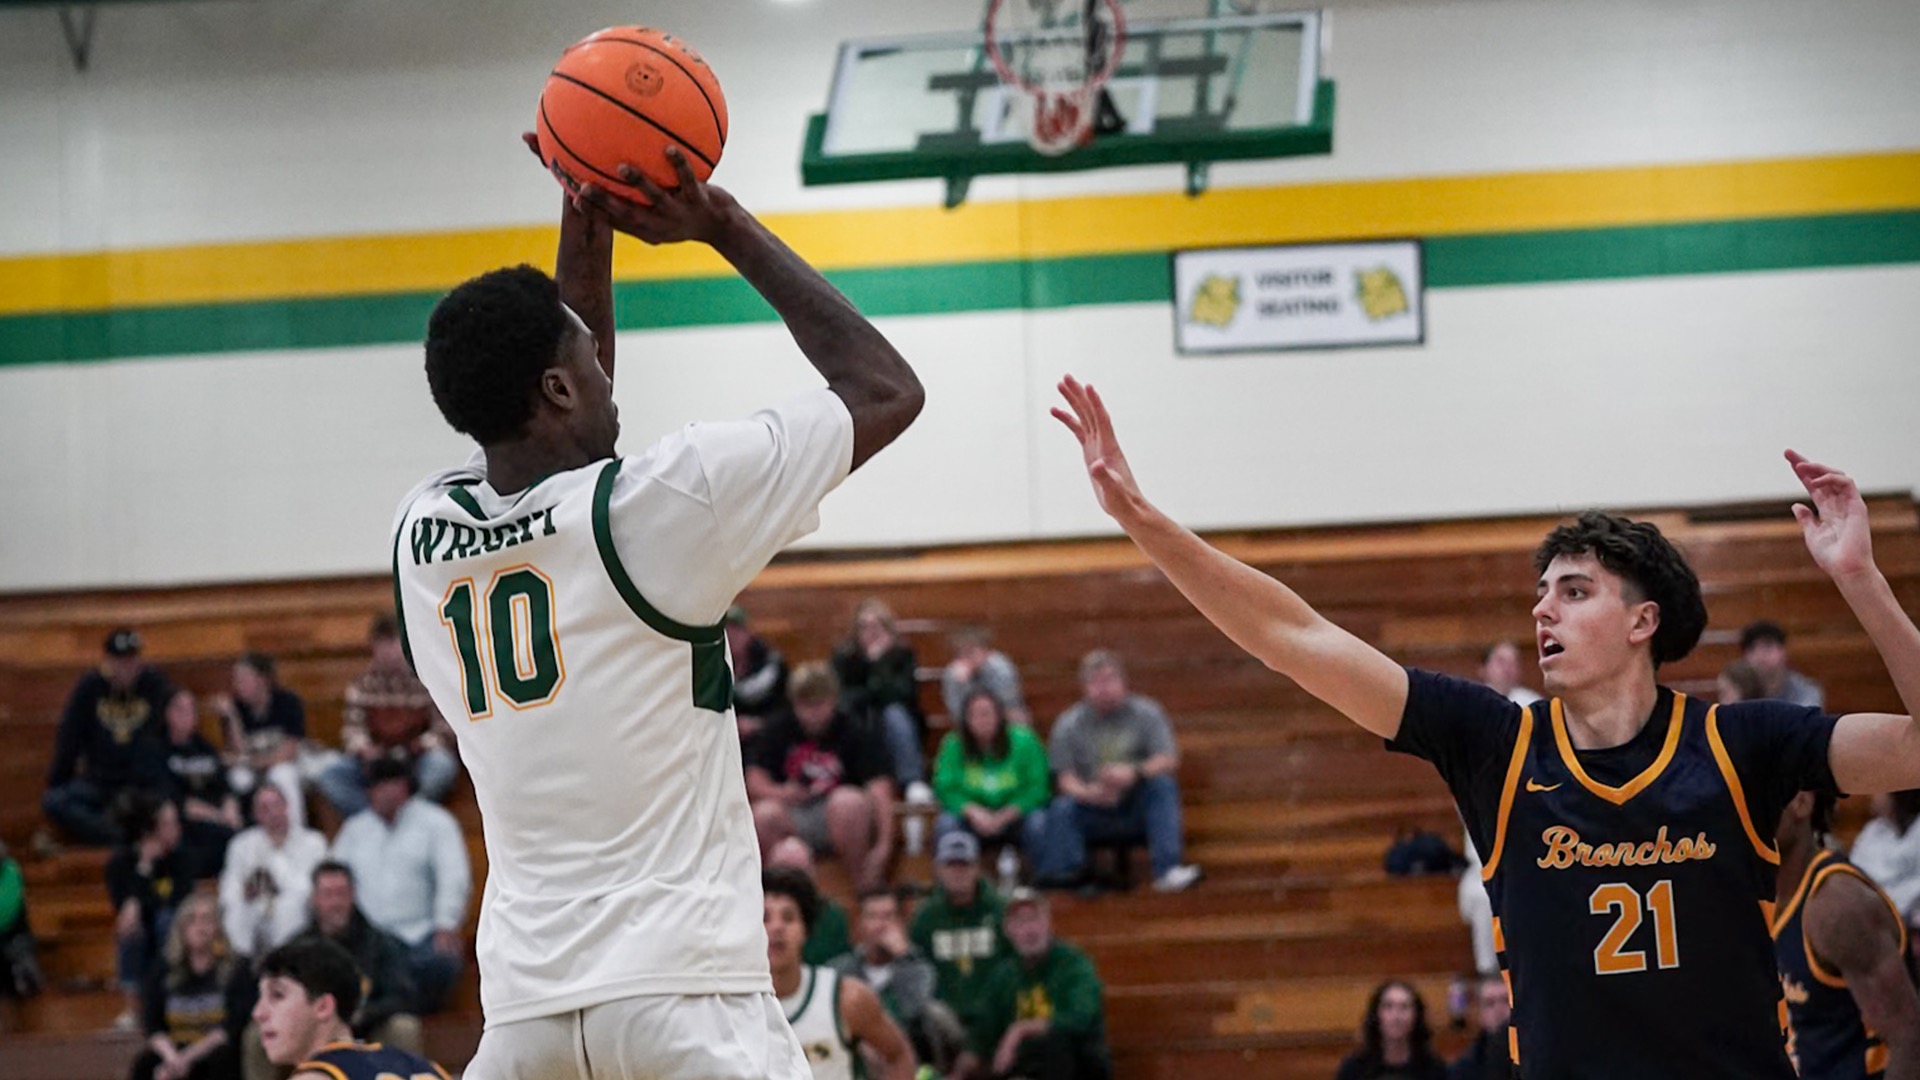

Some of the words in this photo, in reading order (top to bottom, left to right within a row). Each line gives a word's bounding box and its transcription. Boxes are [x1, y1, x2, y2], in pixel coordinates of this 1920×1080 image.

[1256, 269, 1334, 288] VISITOR
[1258, 298, 1341, 317] SEATING
[438, 563, 566, 721] 10
[1537, 825, 1716, 869] Bronchos
[1588, 879, 1680, 975] 21
